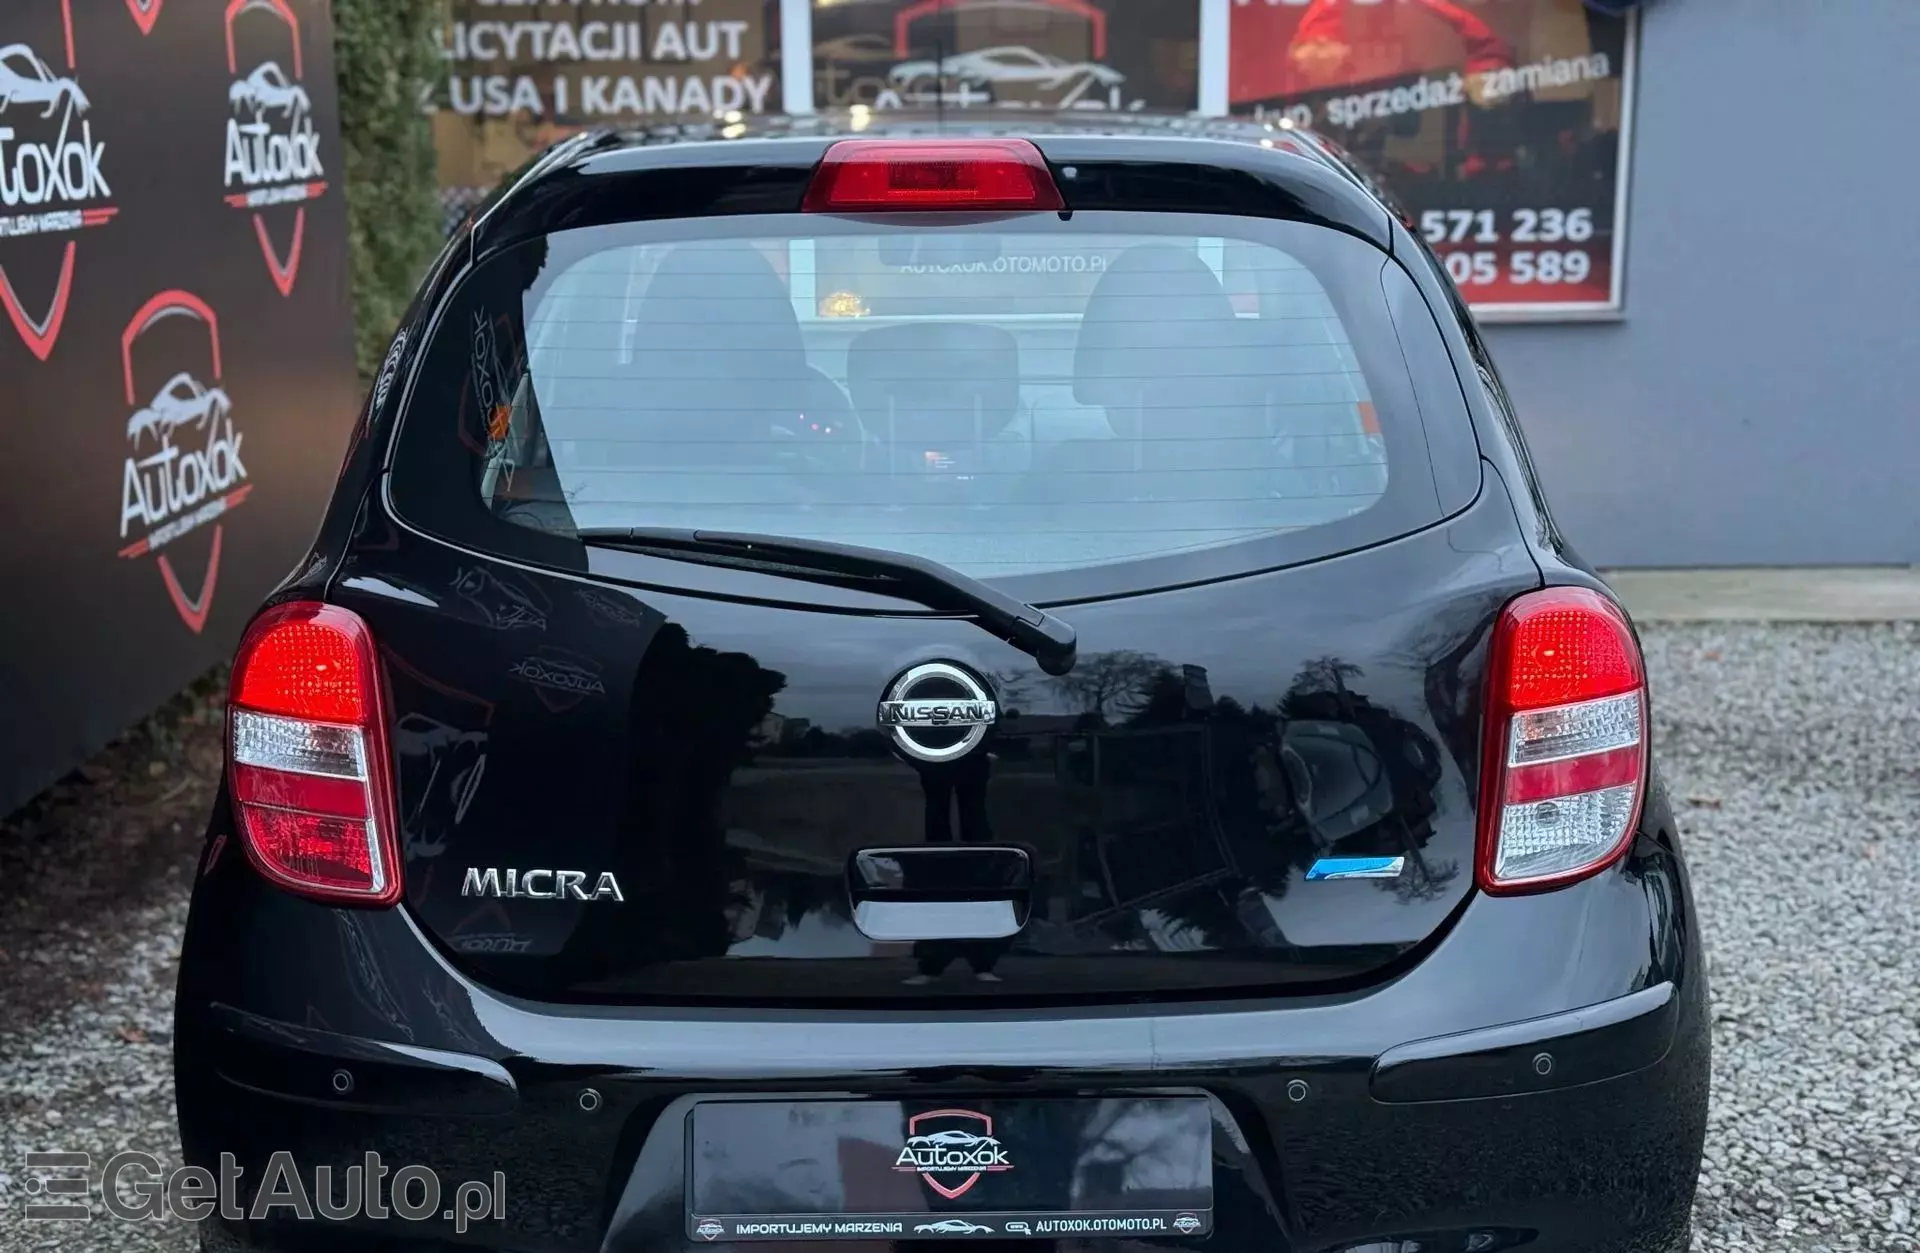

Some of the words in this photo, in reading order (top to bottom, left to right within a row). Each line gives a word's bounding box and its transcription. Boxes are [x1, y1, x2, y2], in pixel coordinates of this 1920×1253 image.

[652, 20, 749, 60] AUT
[449, 74, 545, 115] USA
[553, 75, 569, 114] I
[581, 74, 773, 116] KANADY
[1326, 72, 1464, 128] sprzedaż
[1480, 52, 1610, 99] zamiana
[1420, 208, 1499, 243] 571
[1510, 207, 1594, 242] 236
[1442, 251, 1499, 285] 05
[1508, 250, 1592, 284] 589
[889, 703, 987, 723] NISSAN
[461, 867, 625, 902] MICRA
[736, 1223, 832, 1235] IMPORTUJEMY
[835, 1222, 903, 1233] MARZENIA
[1036, 1217, 1167, 1232] AUTOXOK.OTOMOTO.PL
